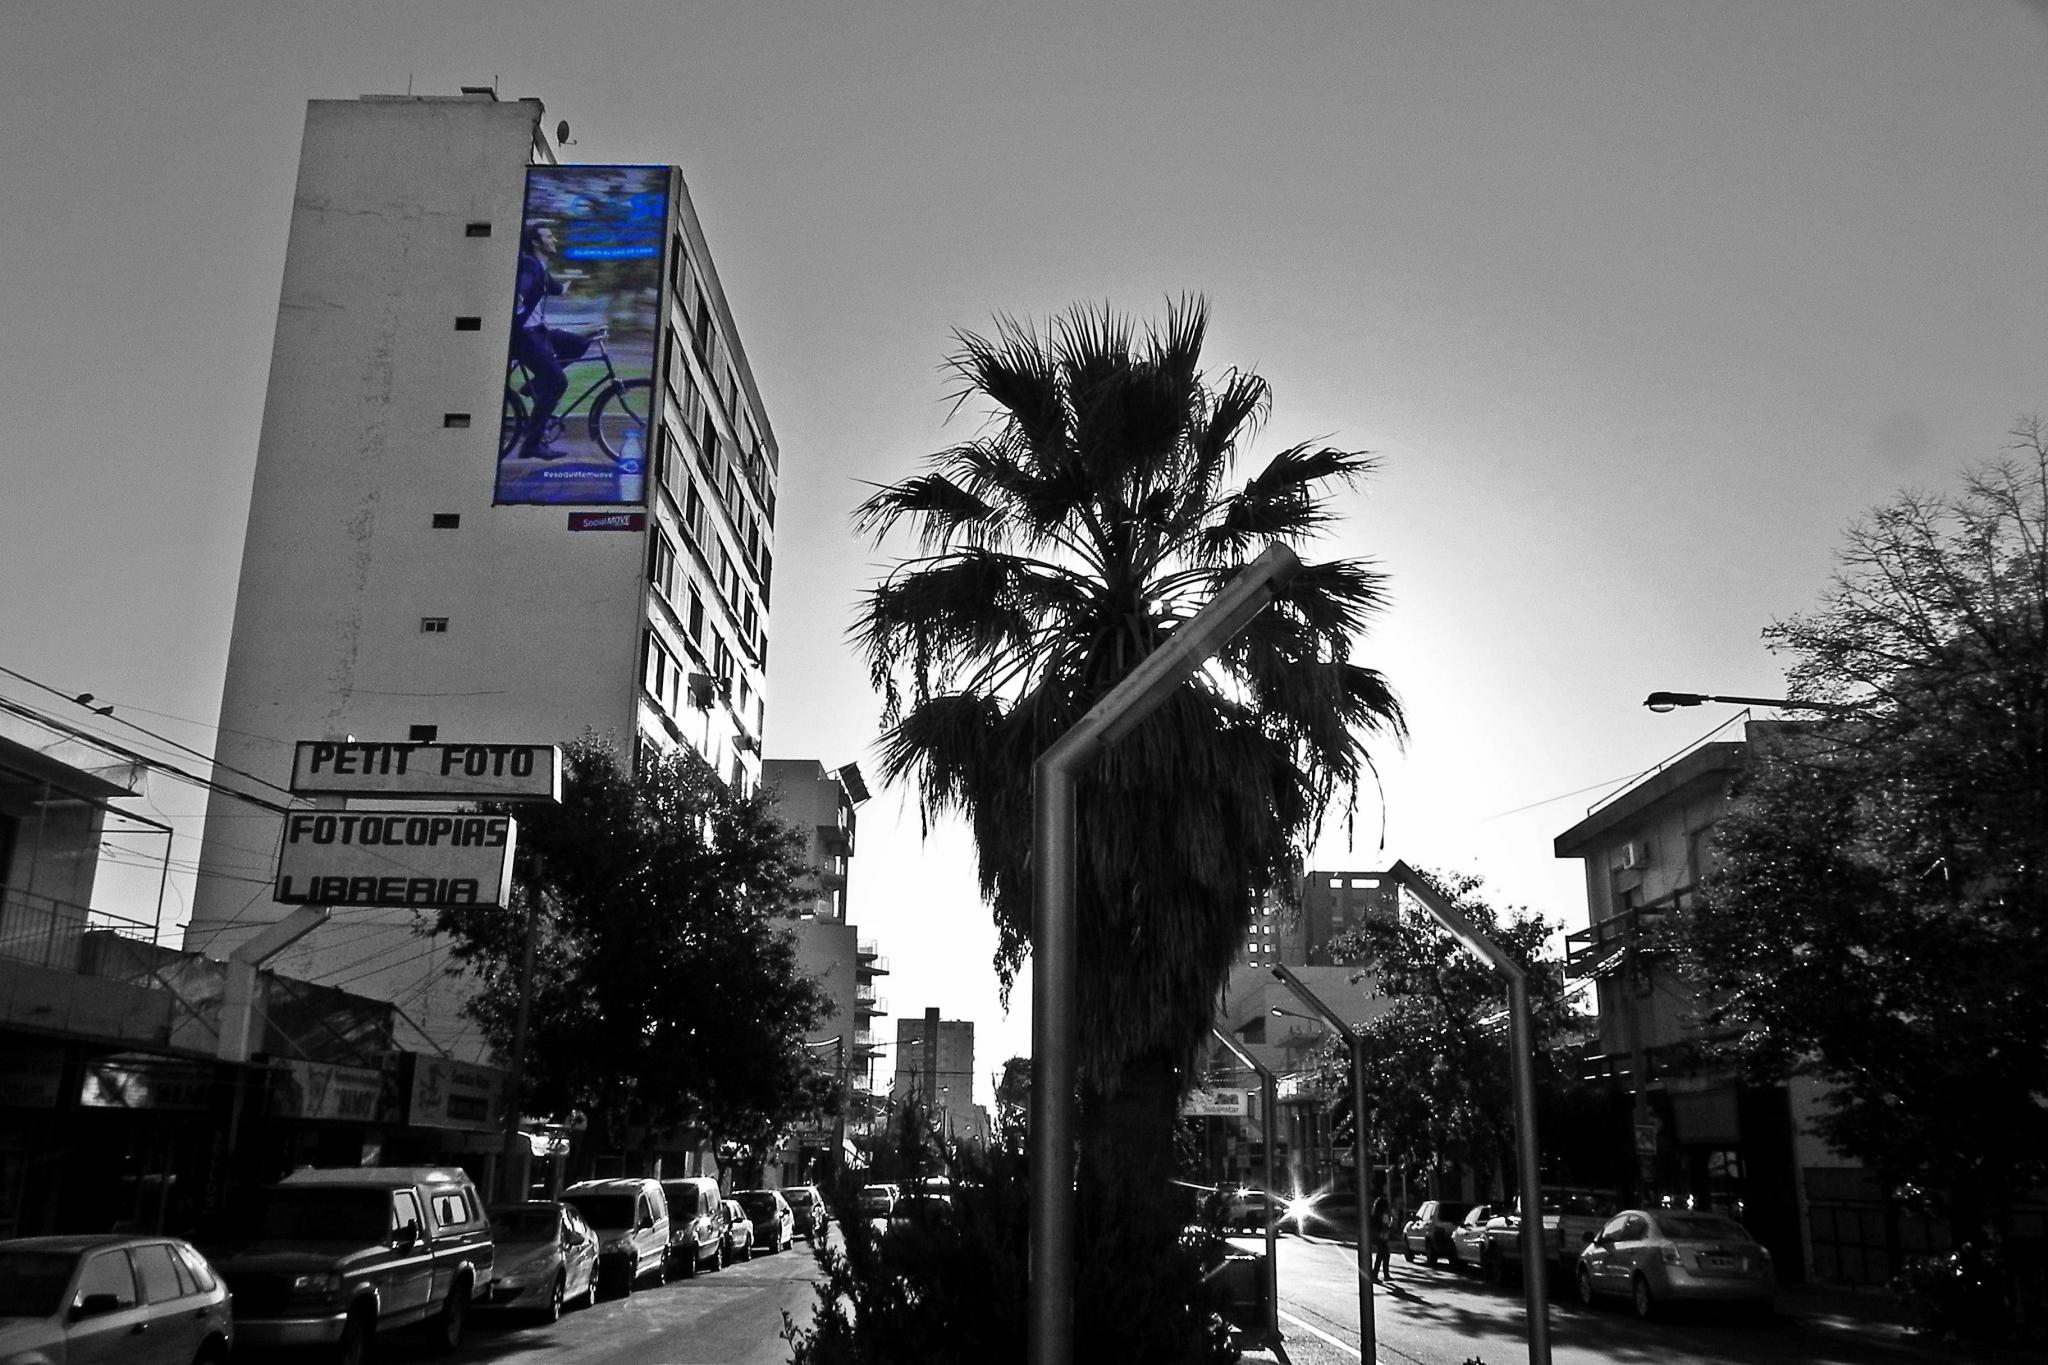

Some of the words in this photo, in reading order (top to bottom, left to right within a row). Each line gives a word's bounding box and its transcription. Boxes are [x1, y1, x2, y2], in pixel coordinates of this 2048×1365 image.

[310, 745, 416, 775] PETIT
[440, 748, 534, 777] FOTO
[289, 815, 508, 847] FOTOCOPIAS
[281, 875, 479, 904] LIBRERIA
